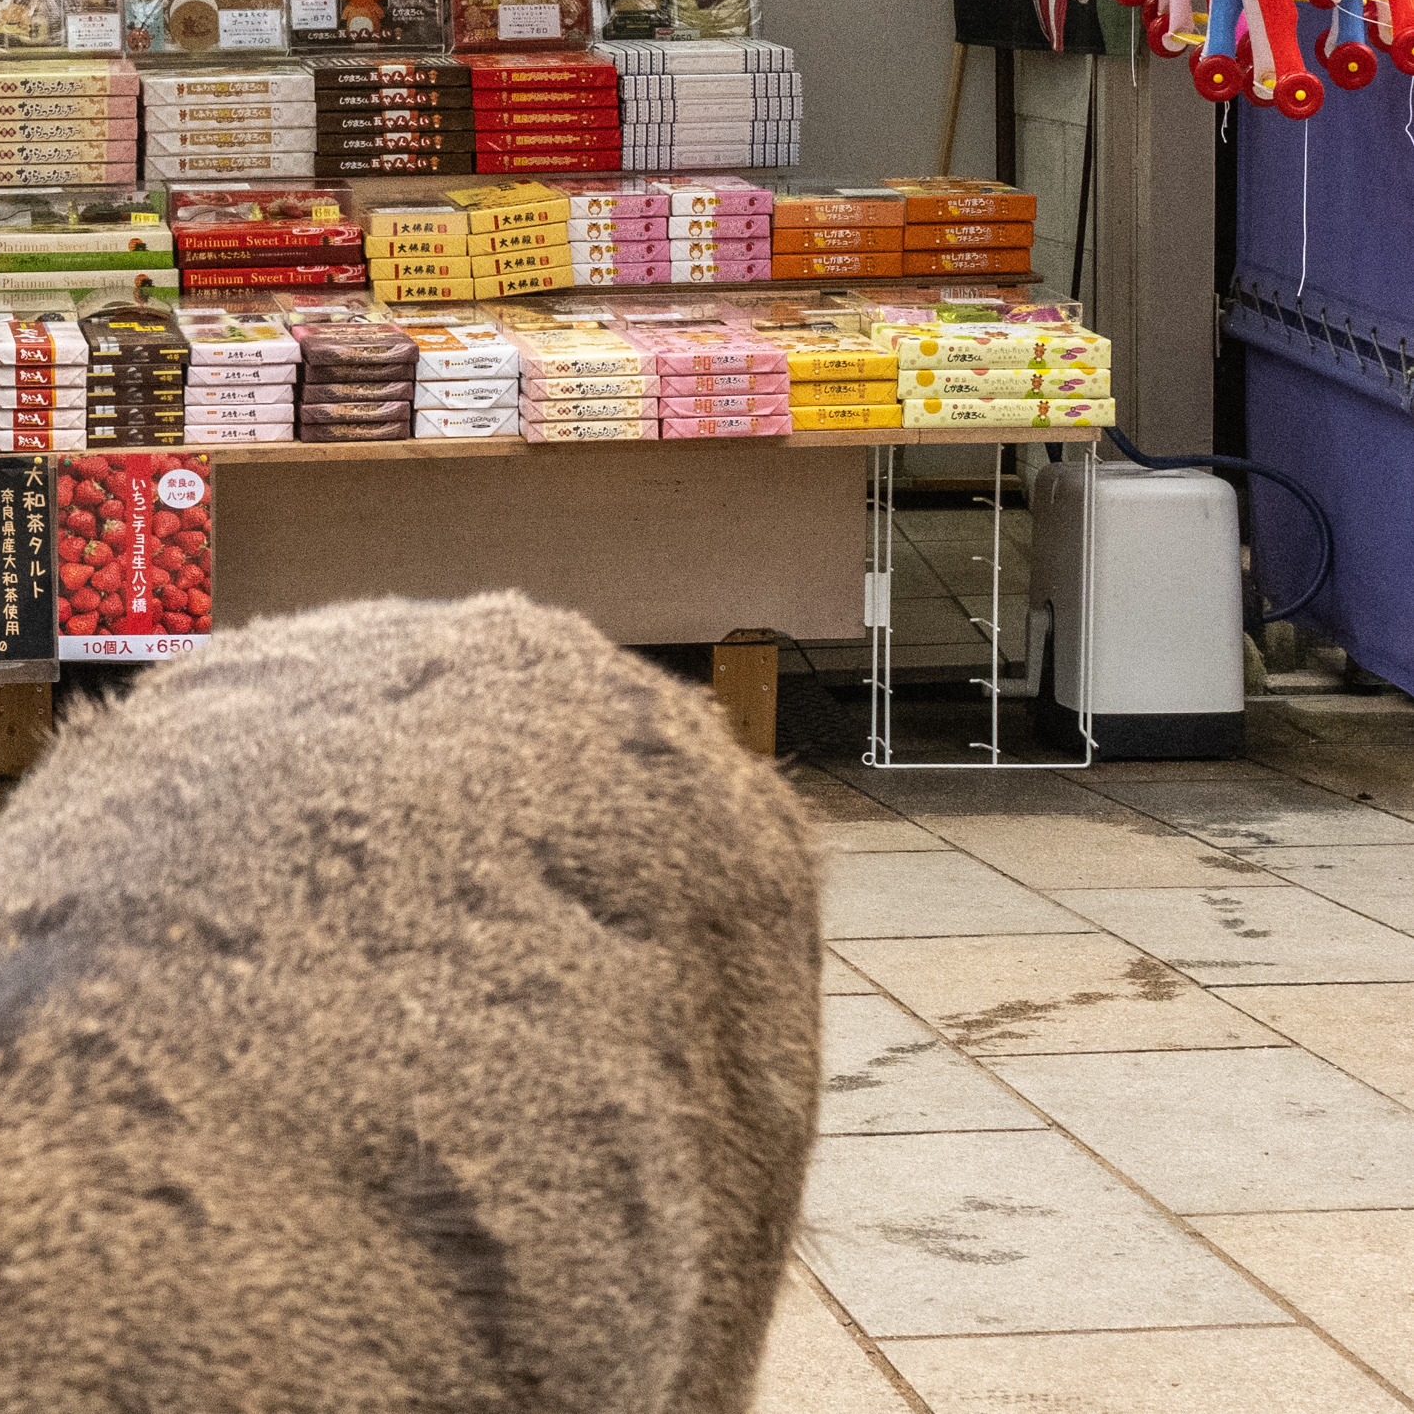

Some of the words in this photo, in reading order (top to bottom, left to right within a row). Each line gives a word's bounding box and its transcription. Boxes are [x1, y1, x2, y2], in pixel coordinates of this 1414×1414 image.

[502, 212, 535, 225] 大佛殿
[401, 223, 434, 233] 大佛殿
[57, 239, 90, 252] Sweet
[93, 239, 119, 251] Tart
[184, 235, 240, 248] Platinum
[246, 235, 280, 248] Sweet
[284, 234, 309, 246] Tart
[499, 235, 532, 248] 大佛殿
[397, 243, 430, 253] 大佛殿
[503, 256, 536, 270] 大佛殿
[403, 265, 435, 275] 大佛殿
[190, 272, 244, 285] Platinum
[251, 272, 285, 284] Sweet
[288, 272, 314, 283] Tart
[507, 277, 539, 291] 大佛殿
[404, 287, 437, 297] 大佛殿
[947, 354, 983, 362] しかまろくん
[944, 384, 979, 393] しかまろくん
[951, 411, 986, 420] しかまろくん
[167, 478, 196, 489] 奈良の
[167, 490, 196, 502] 八ツ橋
[23, 465, 47, 600] 大和茶タルト
[131, 477, 148, 613] いちごチョコ生八ツ橋
[1, 488, 20, 636] 奈良県産大和茶使用
[82, 640, 133, 655] 10個入
[145, 638, 194, 654] ¥650
